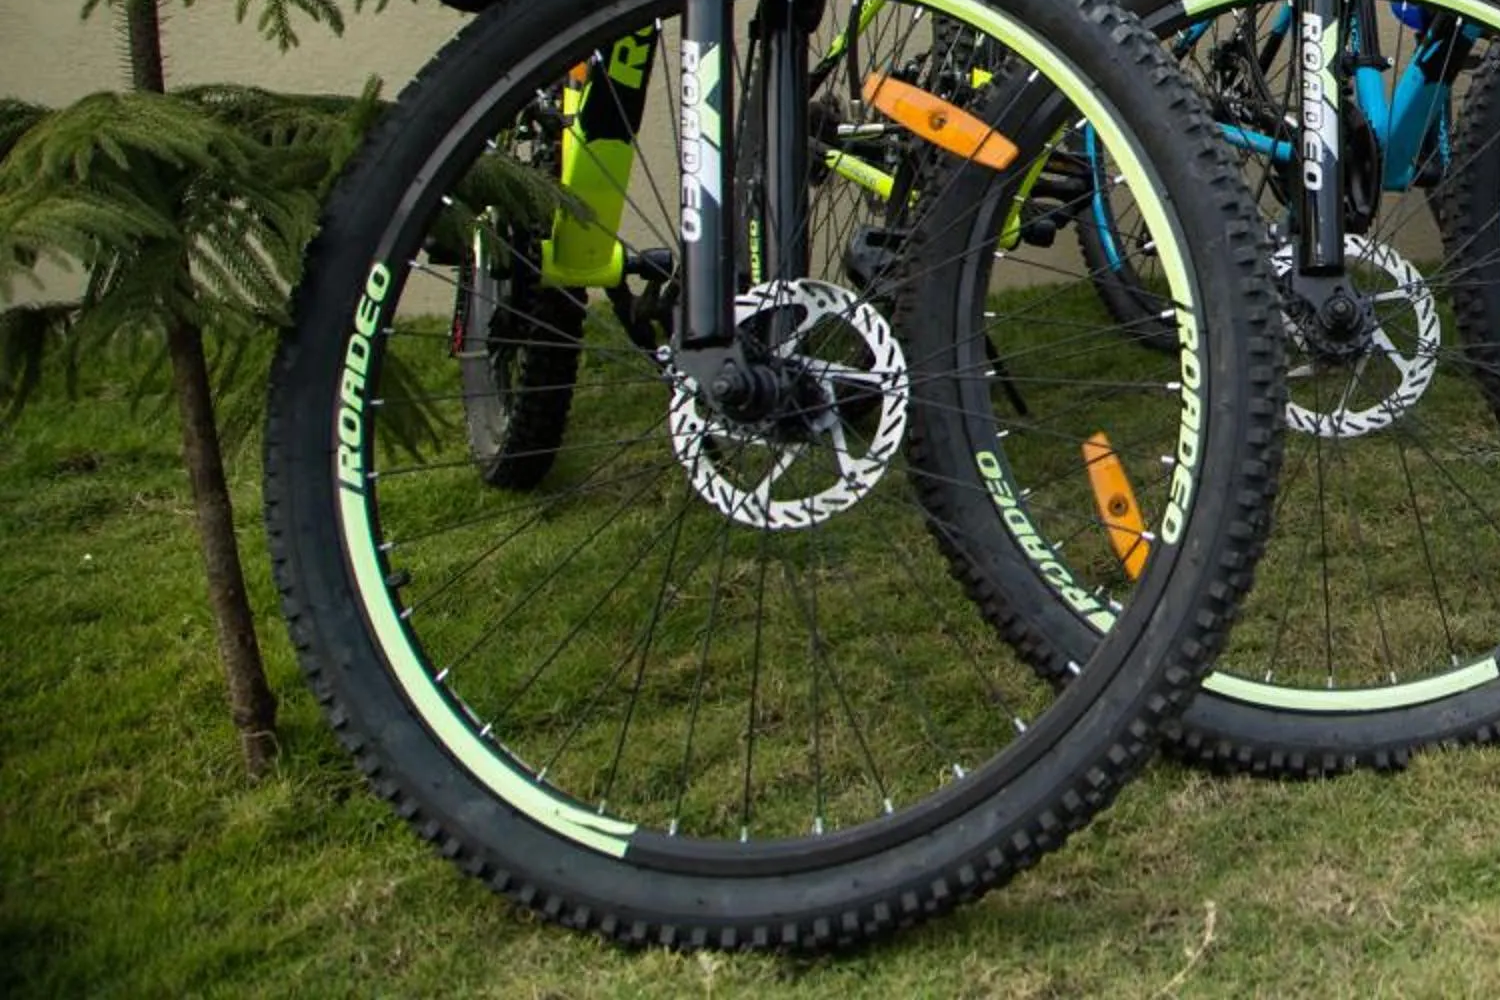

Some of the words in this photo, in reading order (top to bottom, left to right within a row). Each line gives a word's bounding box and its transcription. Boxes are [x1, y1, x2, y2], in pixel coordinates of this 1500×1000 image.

[681, 39, 702, 243] ROADEO
[1302, 12, 1324, 191] ROADEO
[337, 262, 391, 488] ROADEO
[1161, 307, 1201, 544] ROADEO
[975, 451, 1101, 612] ROADEO
